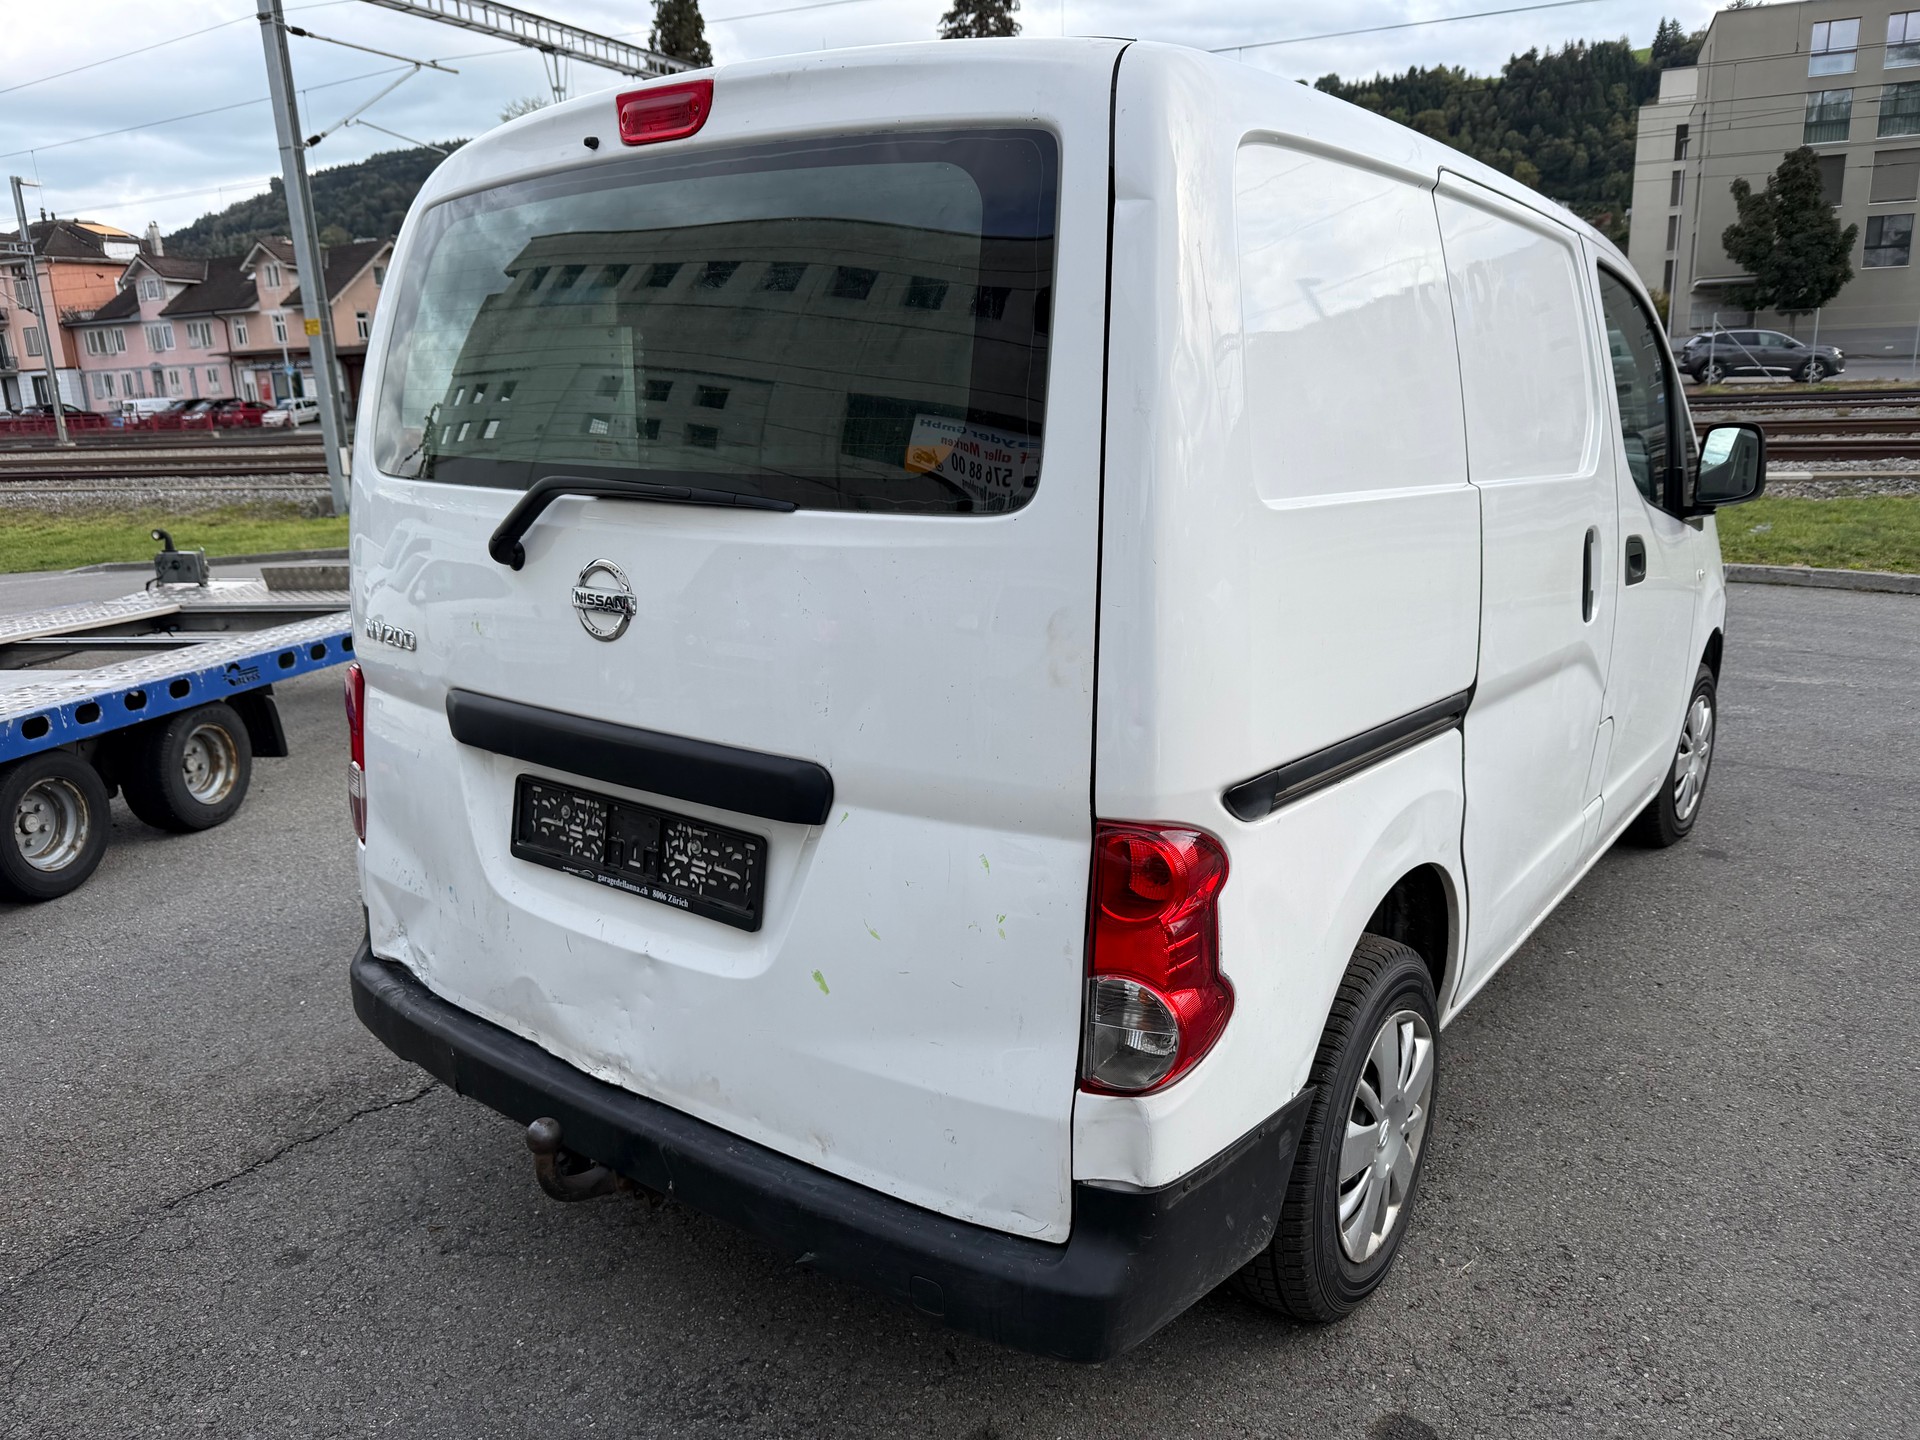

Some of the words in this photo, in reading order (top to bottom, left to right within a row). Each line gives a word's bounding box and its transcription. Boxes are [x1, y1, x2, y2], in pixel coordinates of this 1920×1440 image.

[575, 591, 626, 610] NISSAN
[366, 618, 417, 652] NV200
[597, 874, 648, 895] garagedellanna.ch
[652, 889, 667, 900] 8006
[667, 894, 689, 907] Zürich
